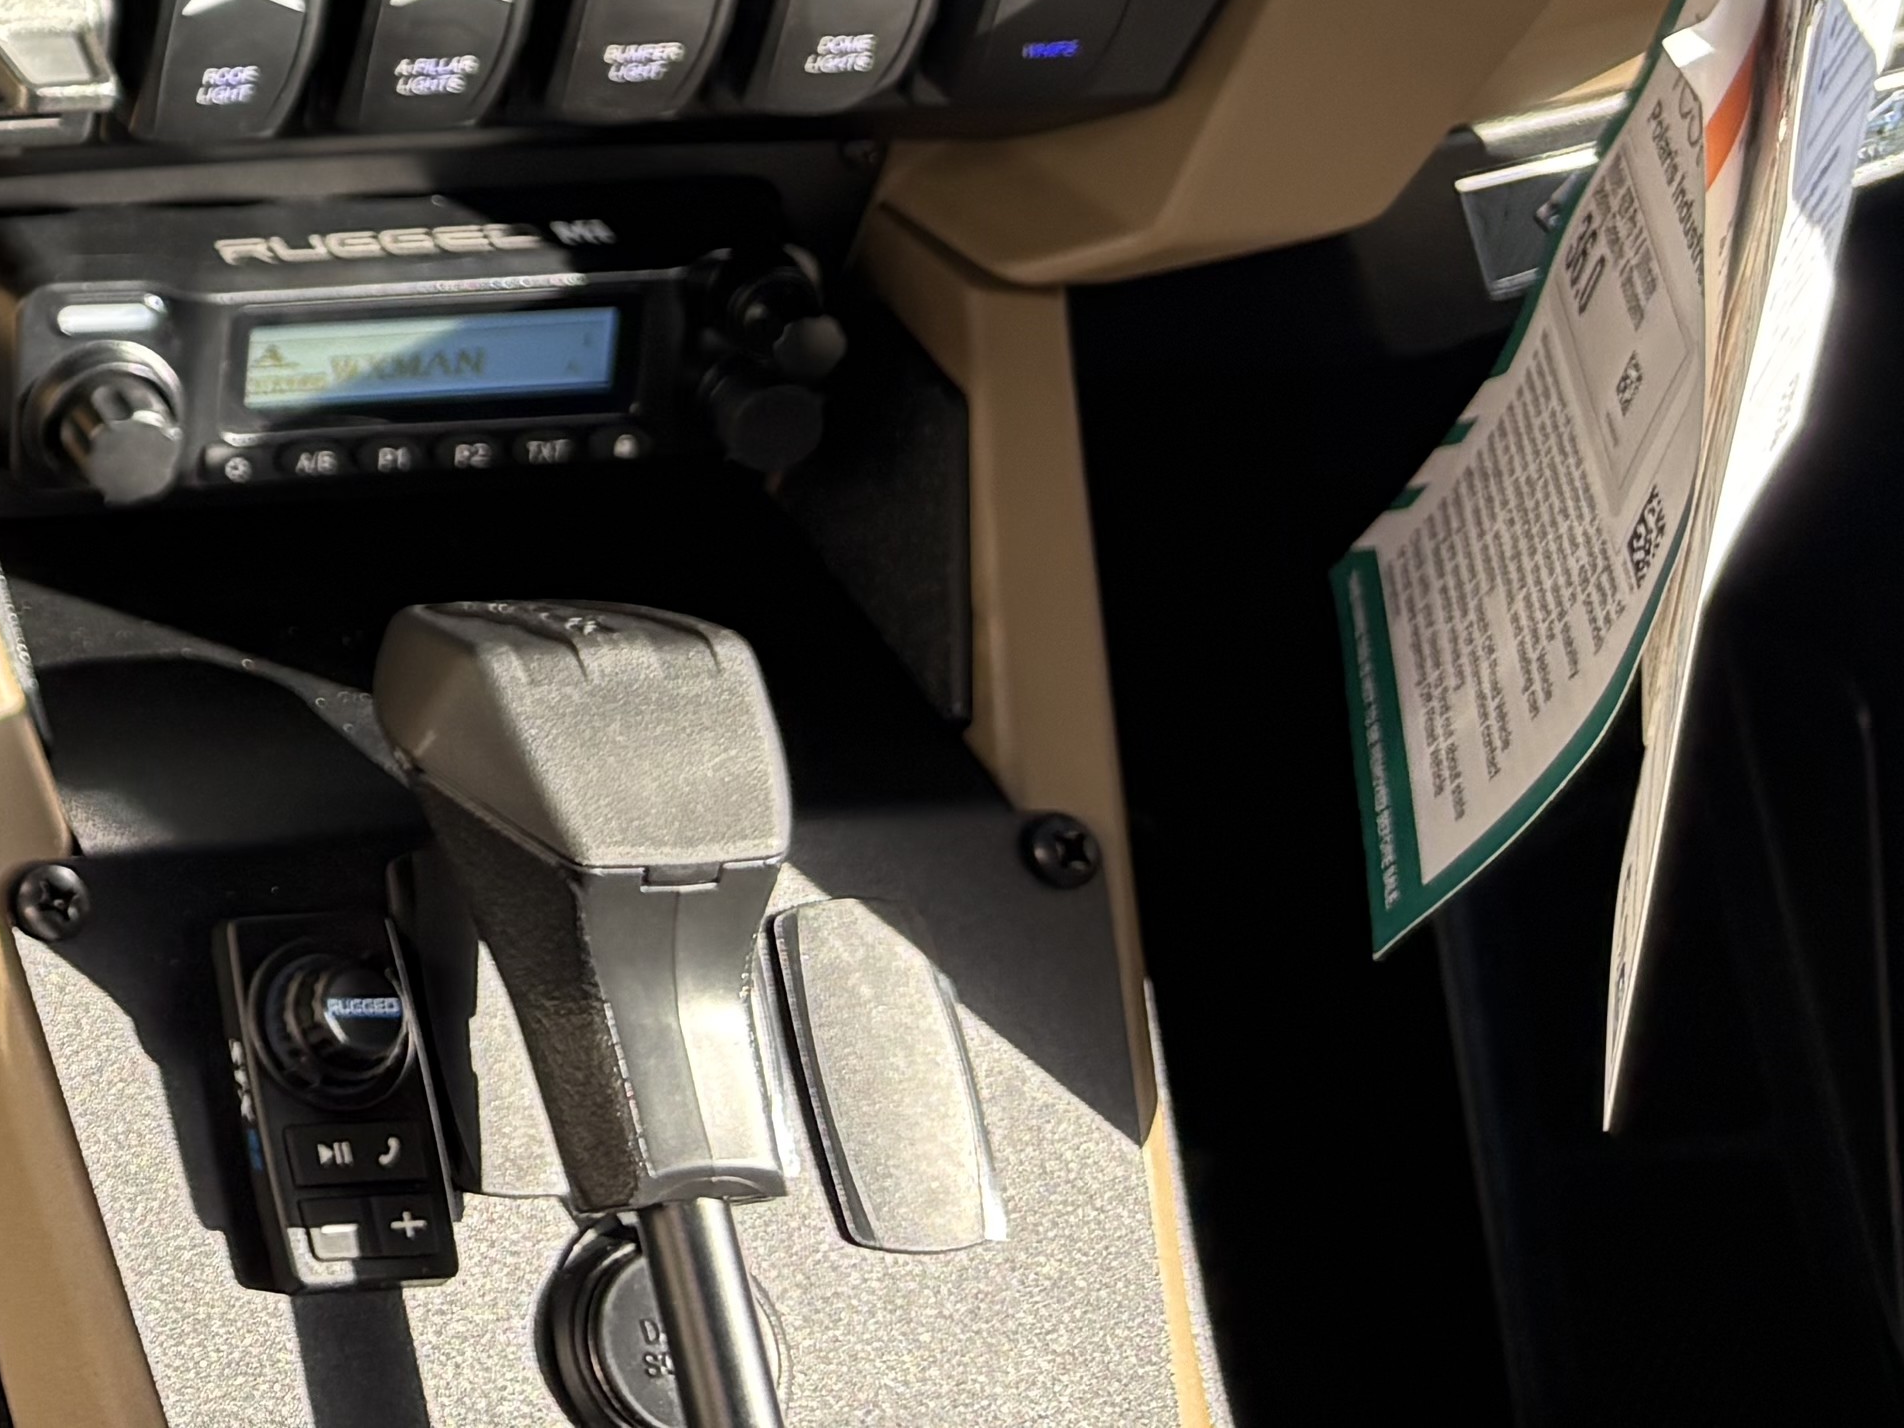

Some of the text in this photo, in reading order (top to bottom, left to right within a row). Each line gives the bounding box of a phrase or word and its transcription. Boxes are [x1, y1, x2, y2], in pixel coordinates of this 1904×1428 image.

[1647, 100, 1681, 186] Polaris
[213, 222, 542, 266] RUGGED
[326, 997, 402, 1018] RUGGED
